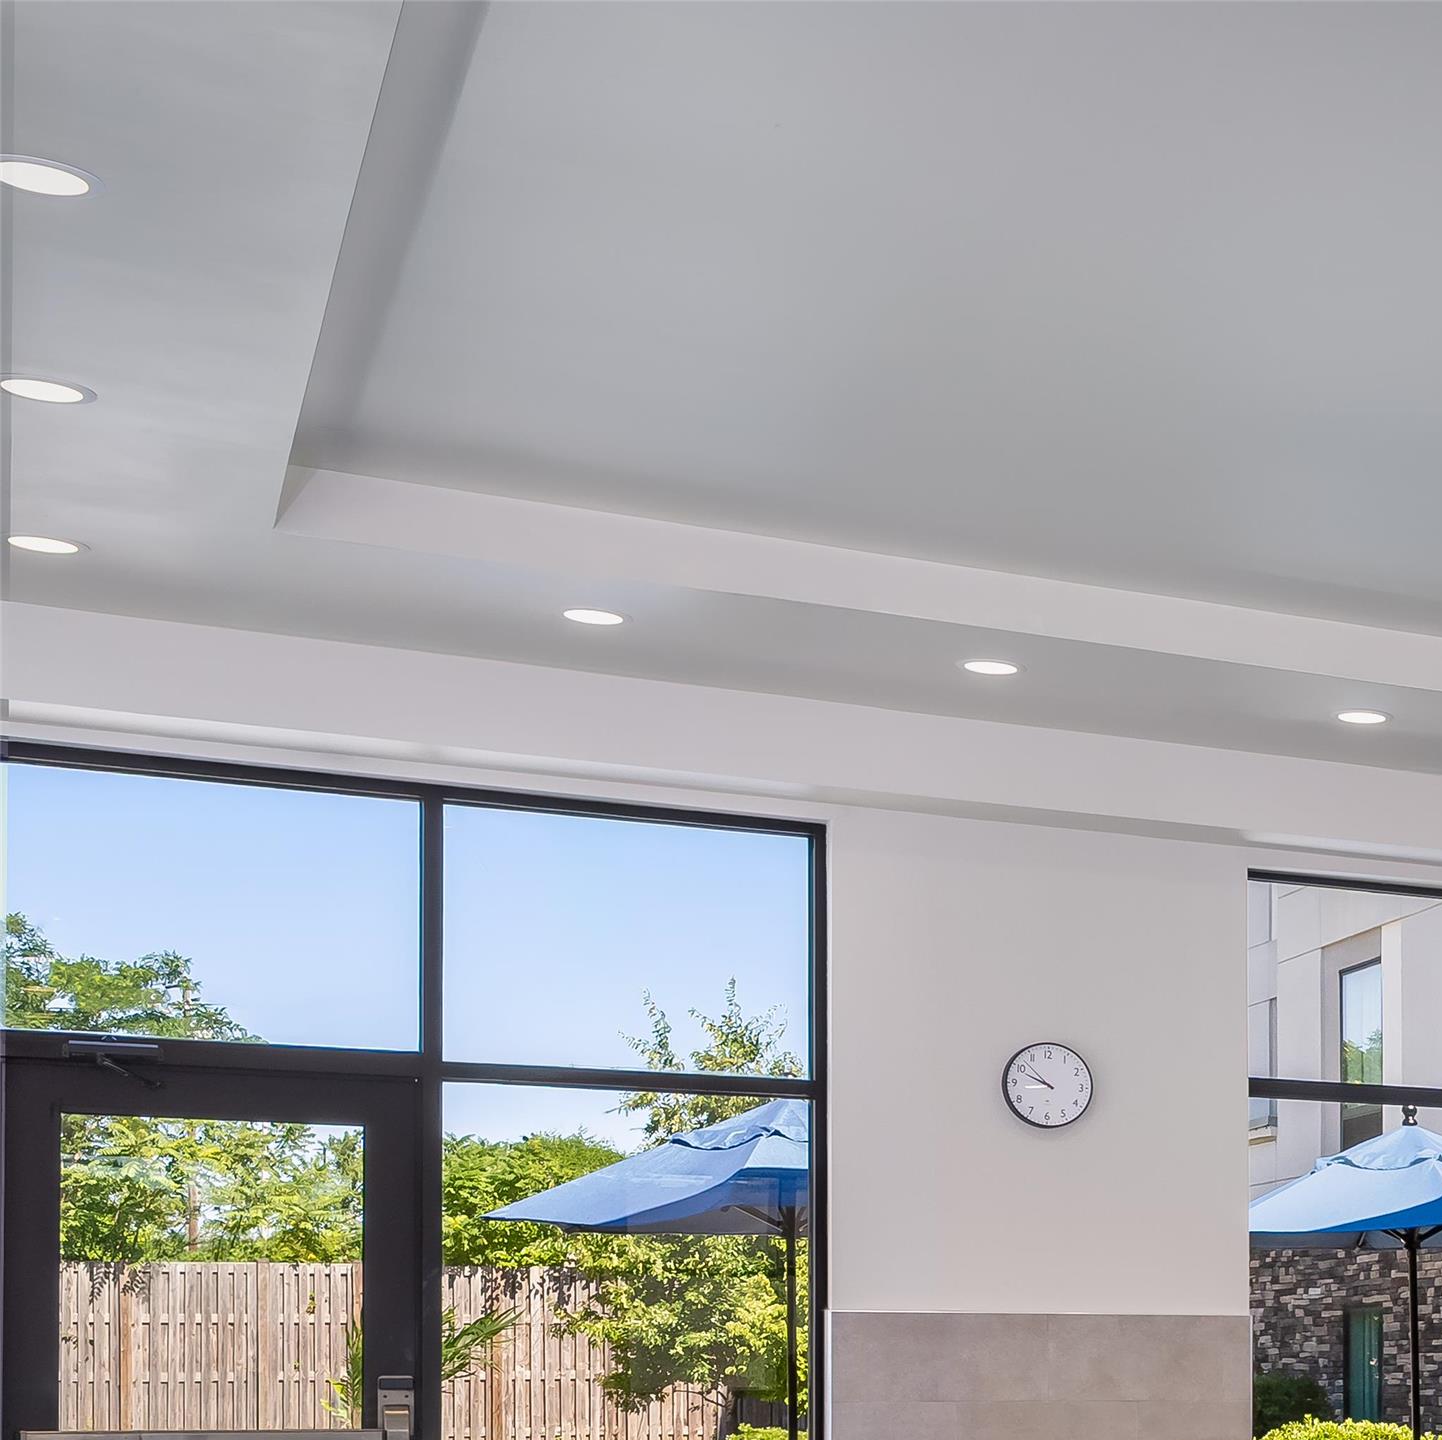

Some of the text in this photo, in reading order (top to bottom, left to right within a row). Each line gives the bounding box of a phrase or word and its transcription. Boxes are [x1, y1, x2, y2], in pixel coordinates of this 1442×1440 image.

[1029, 1053, 1035, 1062] 11
[1044, 1050, 1053, 1060] 12
[1016, 1064, 1026, 1074] 10
[1073, 1067, 1080, 1077] 2
[1011, 1078, 1018, 1087] 9
[1078, 1083, 1084, 1093] 3
[1015, 1094, 1023, 1104] 8
[1072, 1099, 1079, 1107] 4
[1028, 1106, 1034, 1115] 7
[1060, 1109, 1066, 1118] 5
[1044, 1111, 1050, 1120] 6
